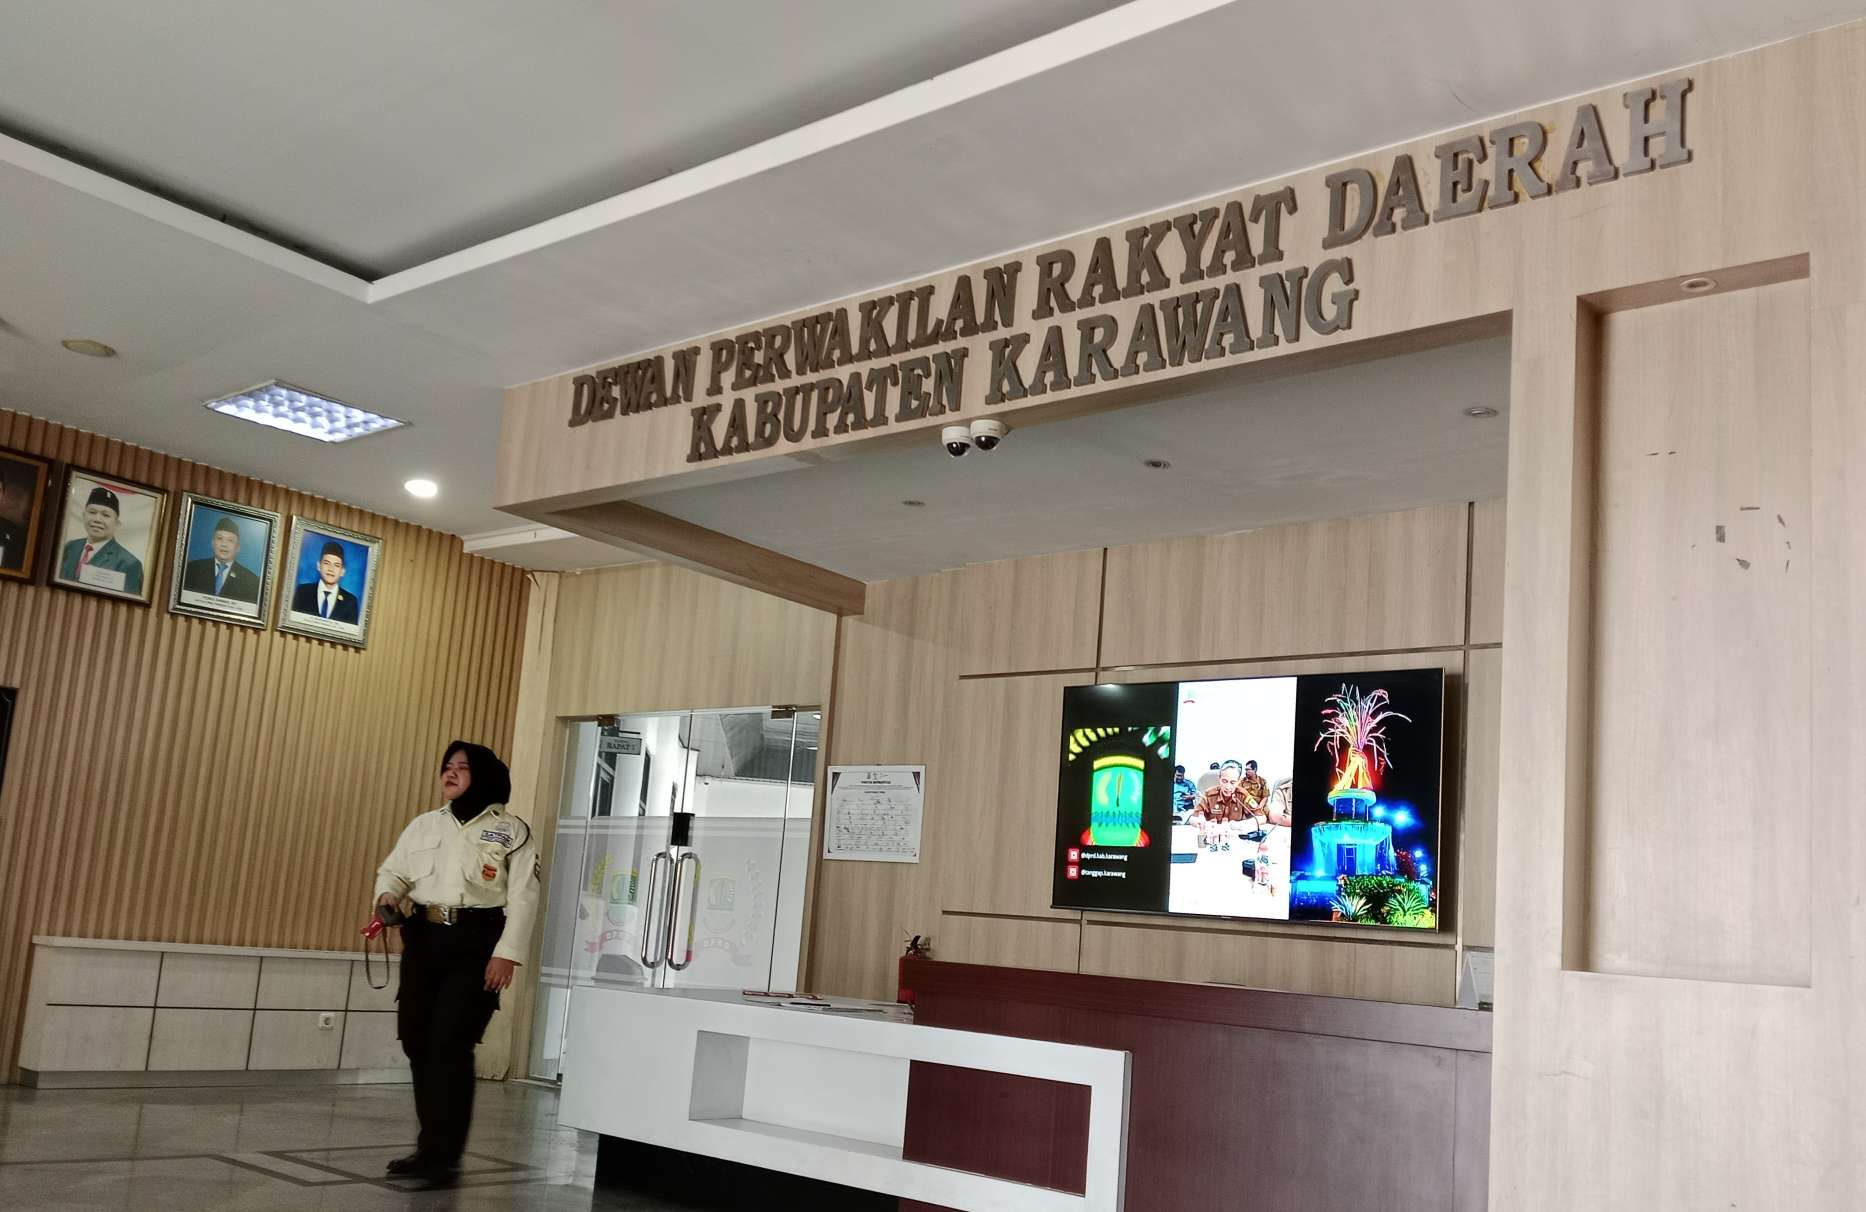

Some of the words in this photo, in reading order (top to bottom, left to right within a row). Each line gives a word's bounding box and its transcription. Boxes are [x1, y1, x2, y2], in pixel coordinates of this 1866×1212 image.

[568, 346, 701, 428] DEWAN
[705, 260, 1023, 399] PERWAKILAN
[1031, 186, 1299, 321] RAKYAT
[1321, 77, 1694, 251] DAERAH
[686, 347, 969, 463] KABUPATEN
[984, 256, 1360, 405] KARAWANG
